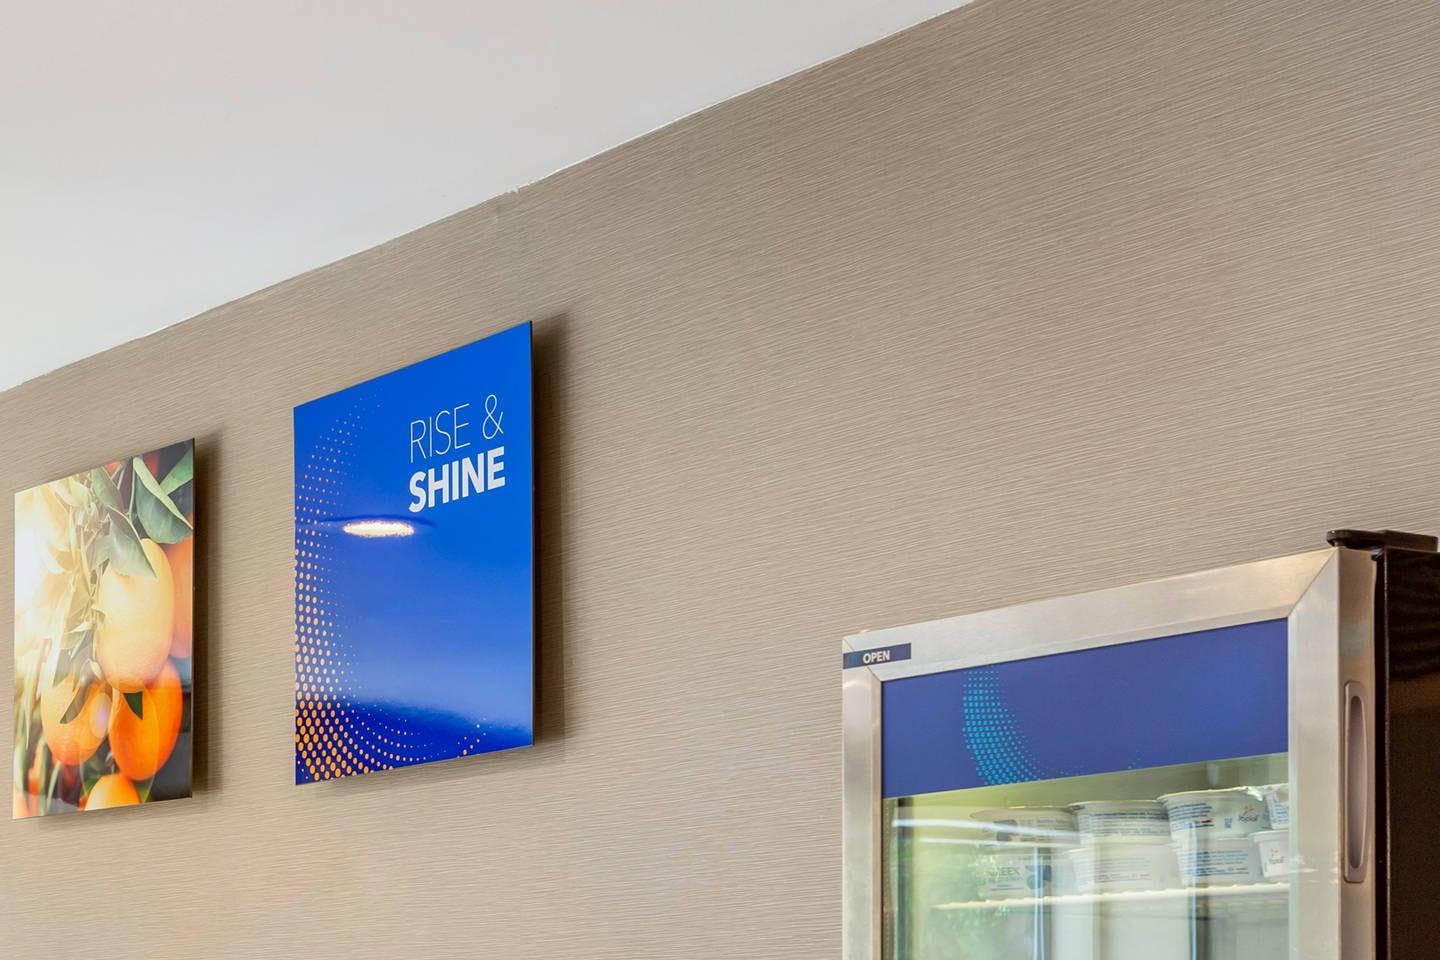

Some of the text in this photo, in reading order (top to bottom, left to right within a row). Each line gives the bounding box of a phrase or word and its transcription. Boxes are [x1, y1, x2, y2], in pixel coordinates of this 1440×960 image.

[410, 394, 504, 463] RISE &
[408, 446, 506, 513] SHINE
[862, 650, 891, 664] OPEN
